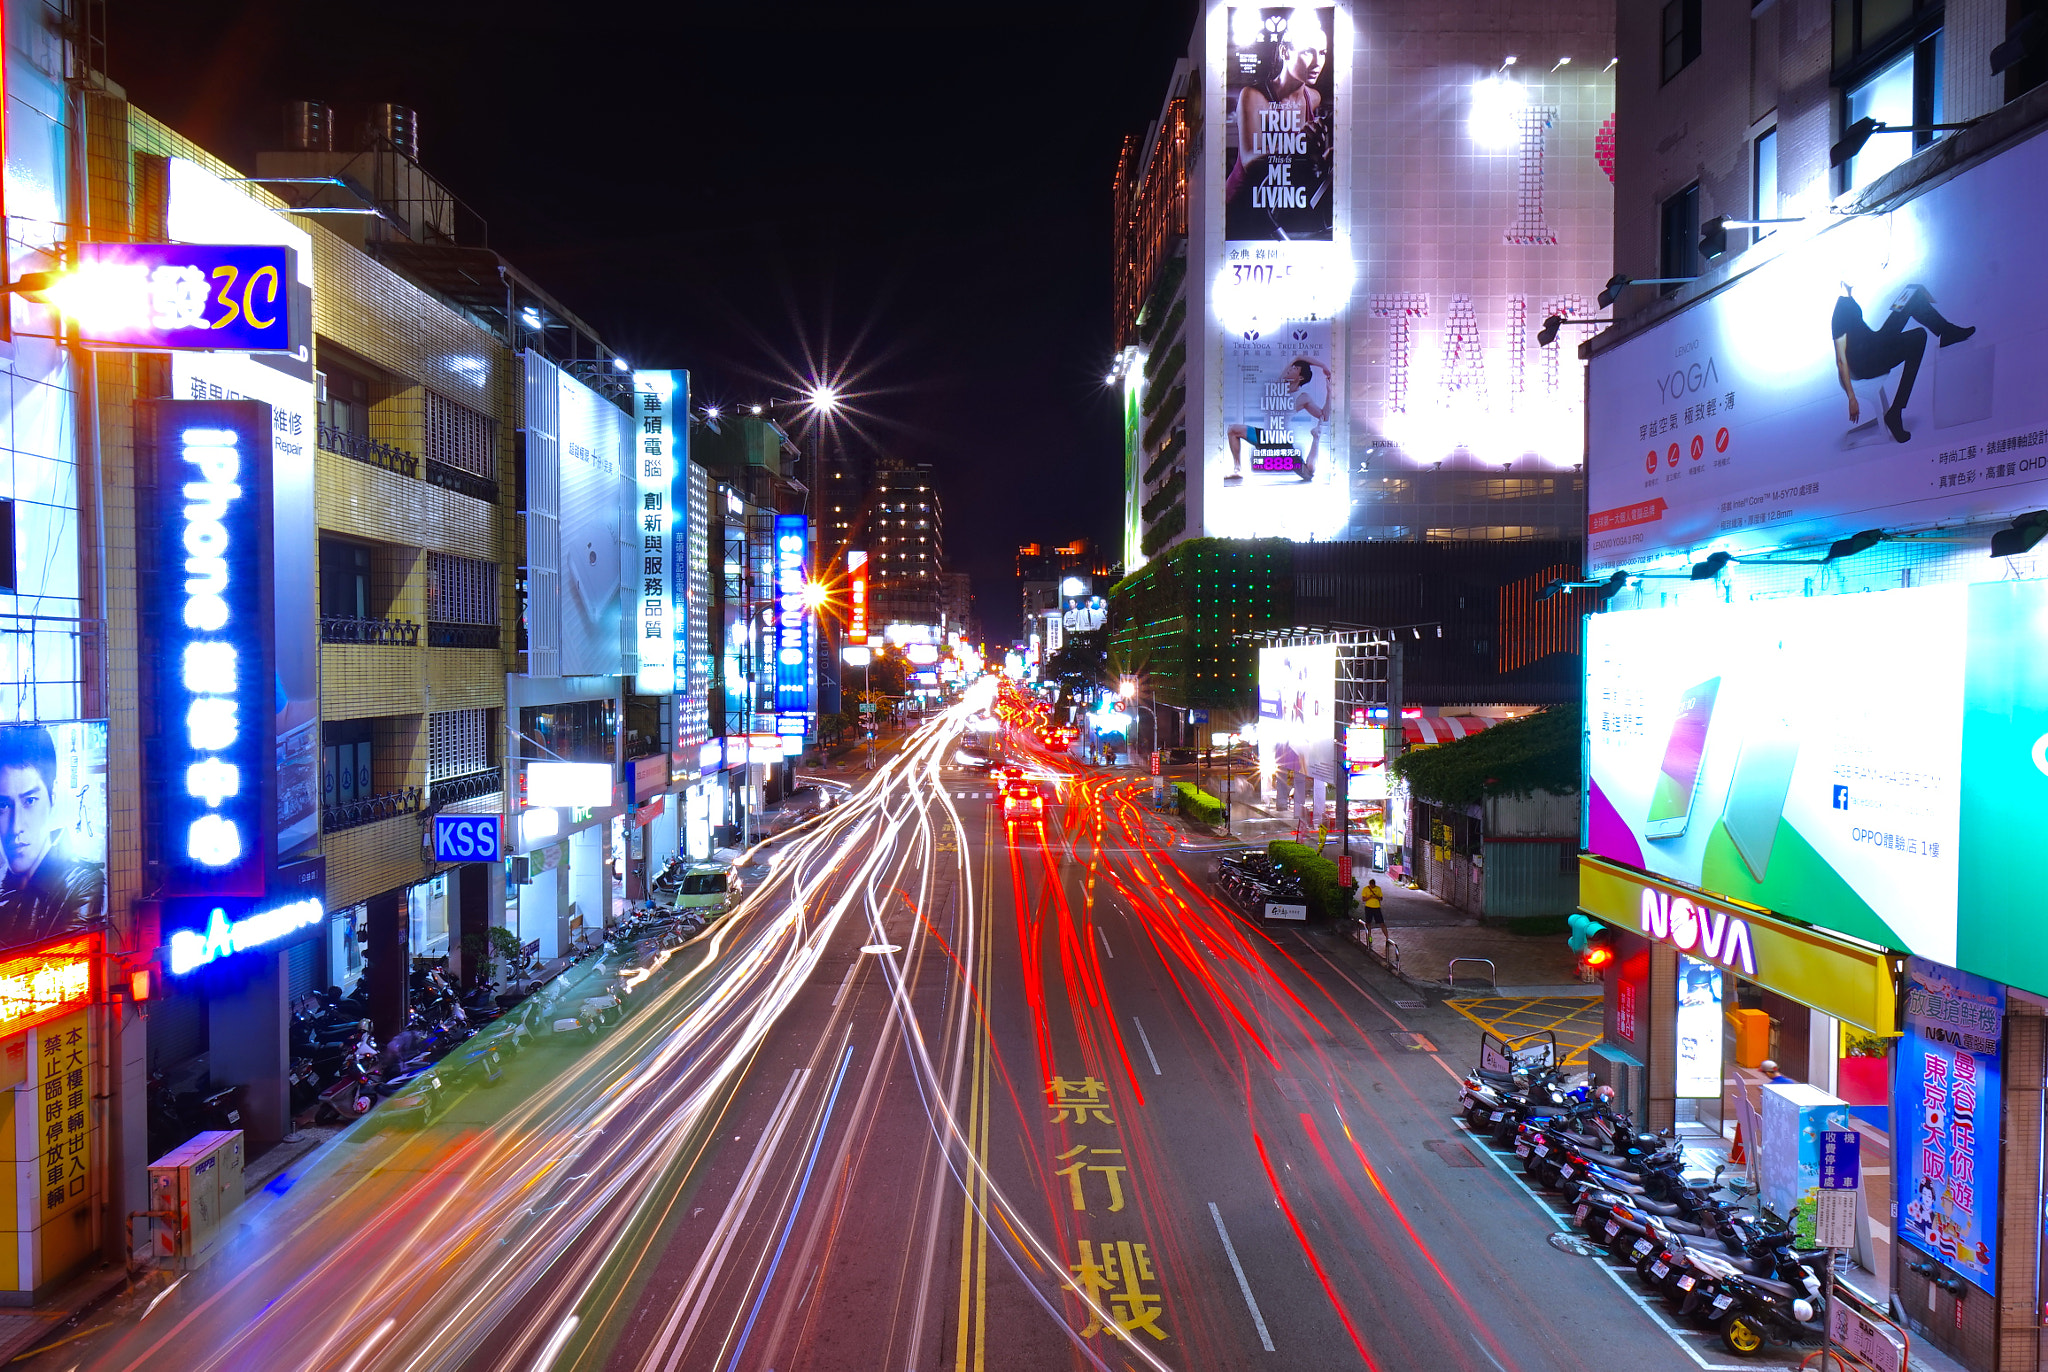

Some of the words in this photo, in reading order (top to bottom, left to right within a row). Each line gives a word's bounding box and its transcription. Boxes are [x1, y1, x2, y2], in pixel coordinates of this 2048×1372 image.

[1259, 110, 1301, 132] TRUE
[1253, 133, 1307, 155] LIVING
[1268, 164, 1291, 185] ME
[1252, 187, 1307, 208] LIVING
[1277, 342, 1296, 350] TRUE
[1297, 342, 1323, 350] DANCE
[1674, 339, 1700, 358] LENOVO
[1264, 382, 1291, 397] TRUE
[1656, 356, 1719, 405] YOGA
[1260, 397, 1294, 411] LIVING
[273, 406, 303, 436] 維修
[1270, 416, 1285, 430] ME
[275, 436, 303, 456] Repair
[643, 394, 662, 477] 華碩電腦
[1260, 430, 1294, 444] LIVING
[1263, 456, 1294, 470] 888
[643, 492, 663, 639] 創新與服務品質
[779, 535, 803, 665] SAMSUNG
[438, 821, 495, 857] KSS
[1852, 827, 1918, 854] OPPO體驗店
[1641, 887, 1757, 975] NOVA
[1909, 989, 1997, 1035] 放夏搶鮮機
[1925, 1026, 1962, 1047] NOVA
[1963, 1033, 1997, 1056] 電腦展
[44, 1033, 65, 1211] 禁止臨時停放車輛
[65, 1026, 85, 1198] 本大樓車輛出入口
[1824, 1132, 1837, 1188] 收費停車處
